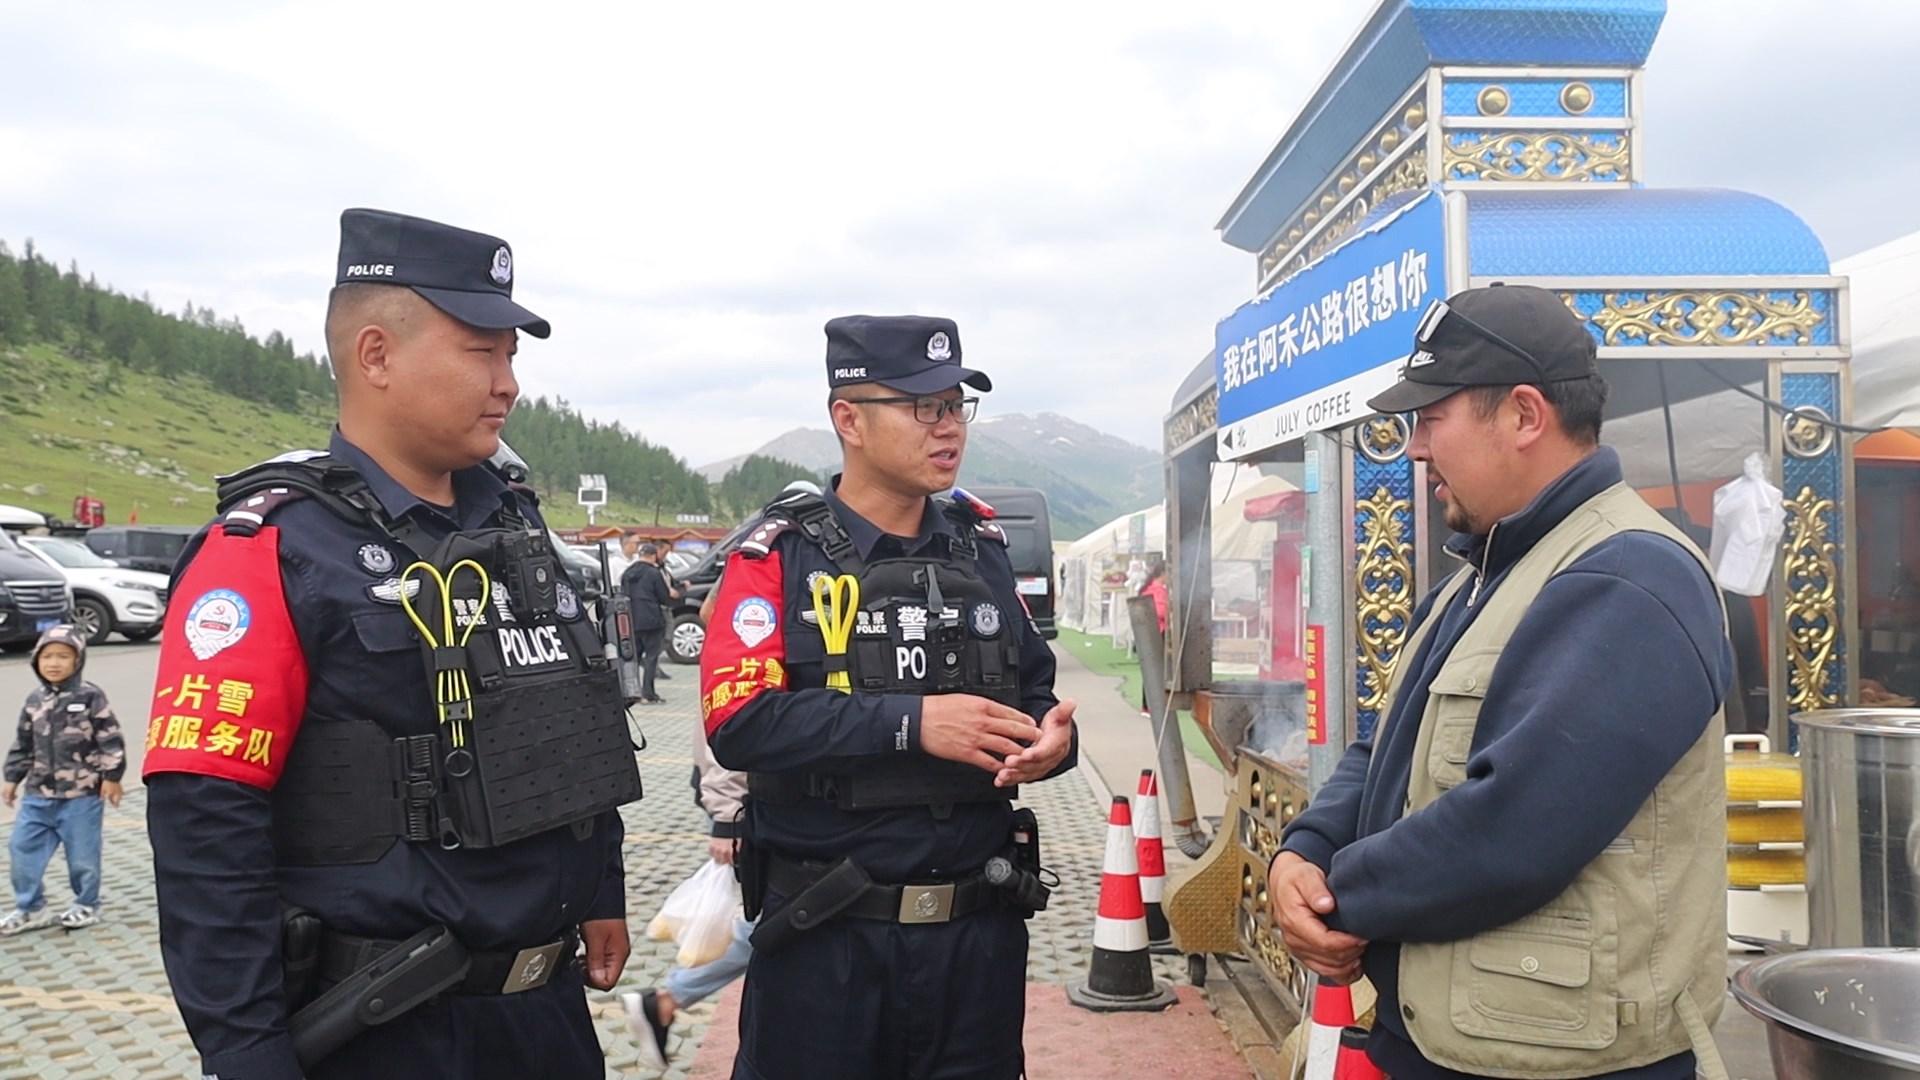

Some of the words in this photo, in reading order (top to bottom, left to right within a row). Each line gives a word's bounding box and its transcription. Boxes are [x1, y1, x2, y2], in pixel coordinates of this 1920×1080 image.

[346, 264, 395, 277] POLICE
[1223, 249, 1428, 393] 我在阿禾公路很想你
[834, 367, 867, 379] POLICE
[1275, 409, 1300, 438] JULY
[1306, 391, 1351, 426] COFFEE
[856, 624, 888, 634] POLICE
[857, 611, 885, 625] 警察
[498, 625, 569, 667] POLICE
[713, 657, 784, 687] 一片雪
[157, 674, 254, 717] 一片雪
